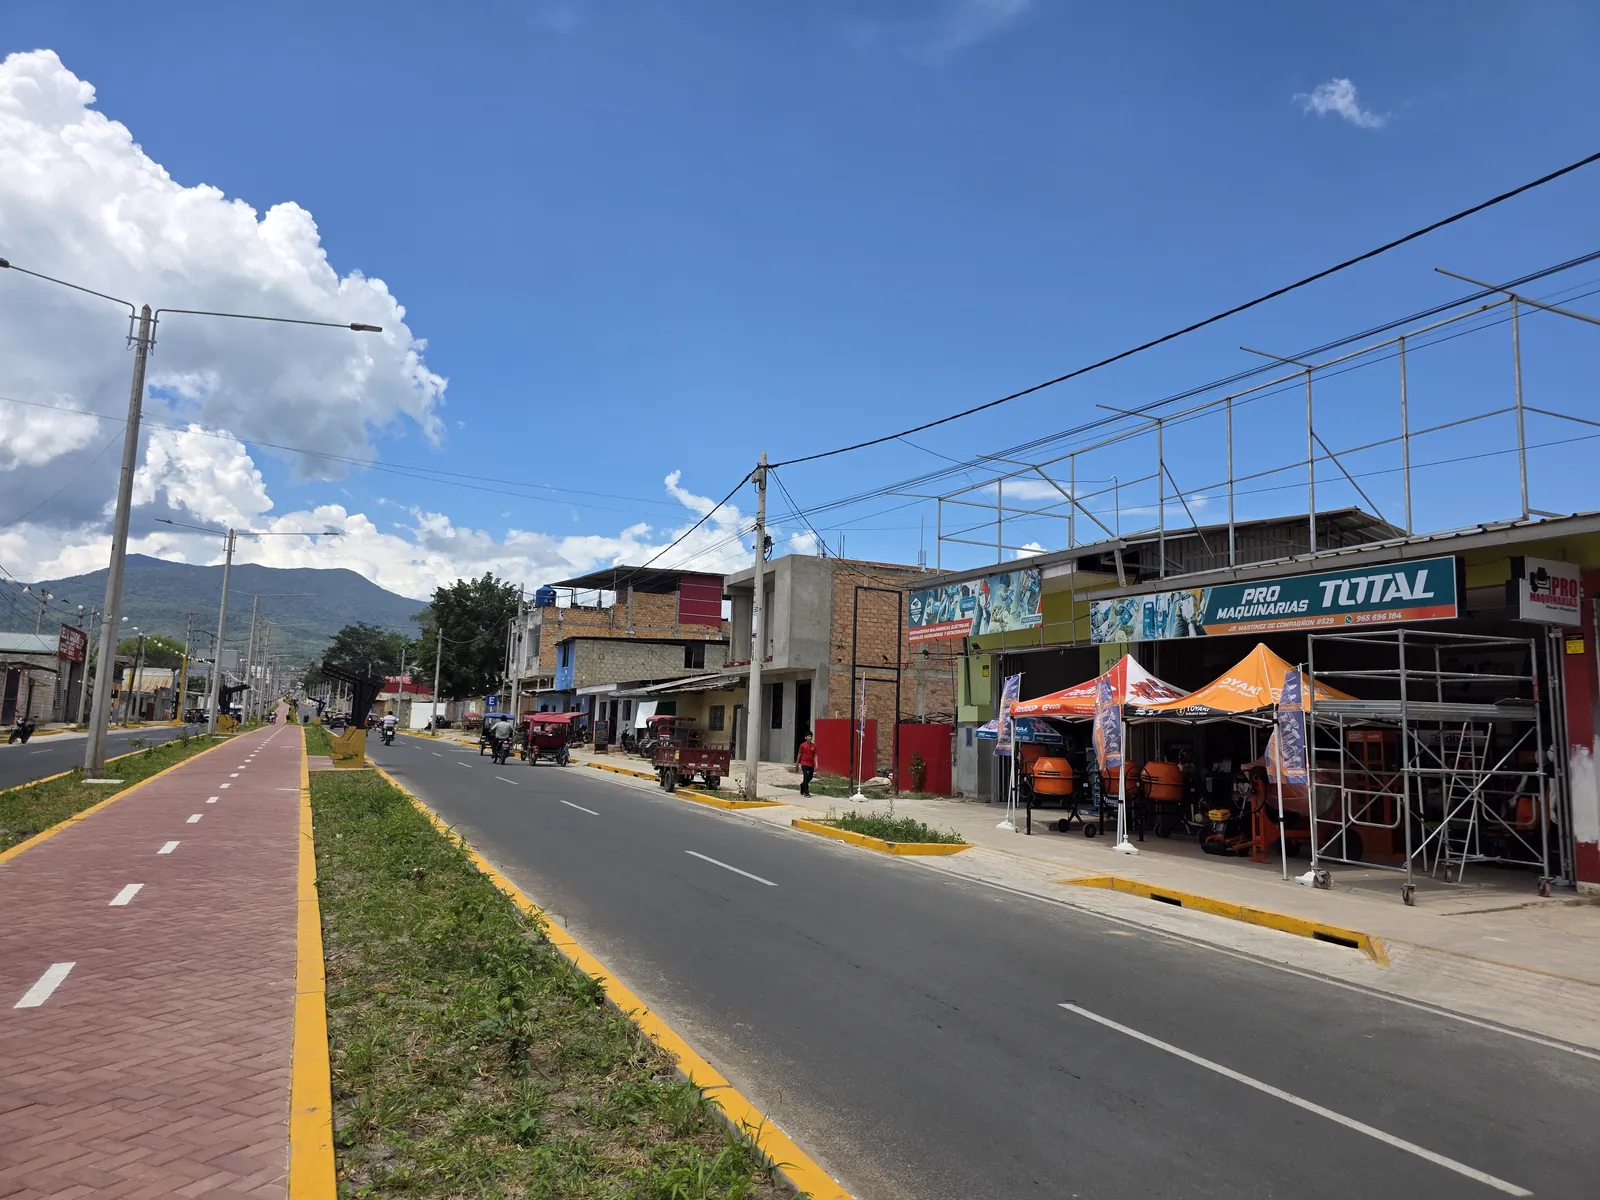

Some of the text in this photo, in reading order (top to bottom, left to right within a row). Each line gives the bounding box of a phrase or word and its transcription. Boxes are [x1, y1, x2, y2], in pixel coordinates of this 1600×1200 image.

[1241, 585, 1281, 604] PRO
[1319, 569, 1435, 608] TOTAL
[1551, 577, 1578, 598] PRO
[1529, 592, 1578, 607] MAQUINARIAS
[1216, 599, 1309, 620] MAQUINARIAS
[1356, 611, 1402, 623] 965 696 184
[1316, 617, 1335, 625] #529
[1221, 677, 1262, 696] OYAKI
[488, 696, 495, 705] E
